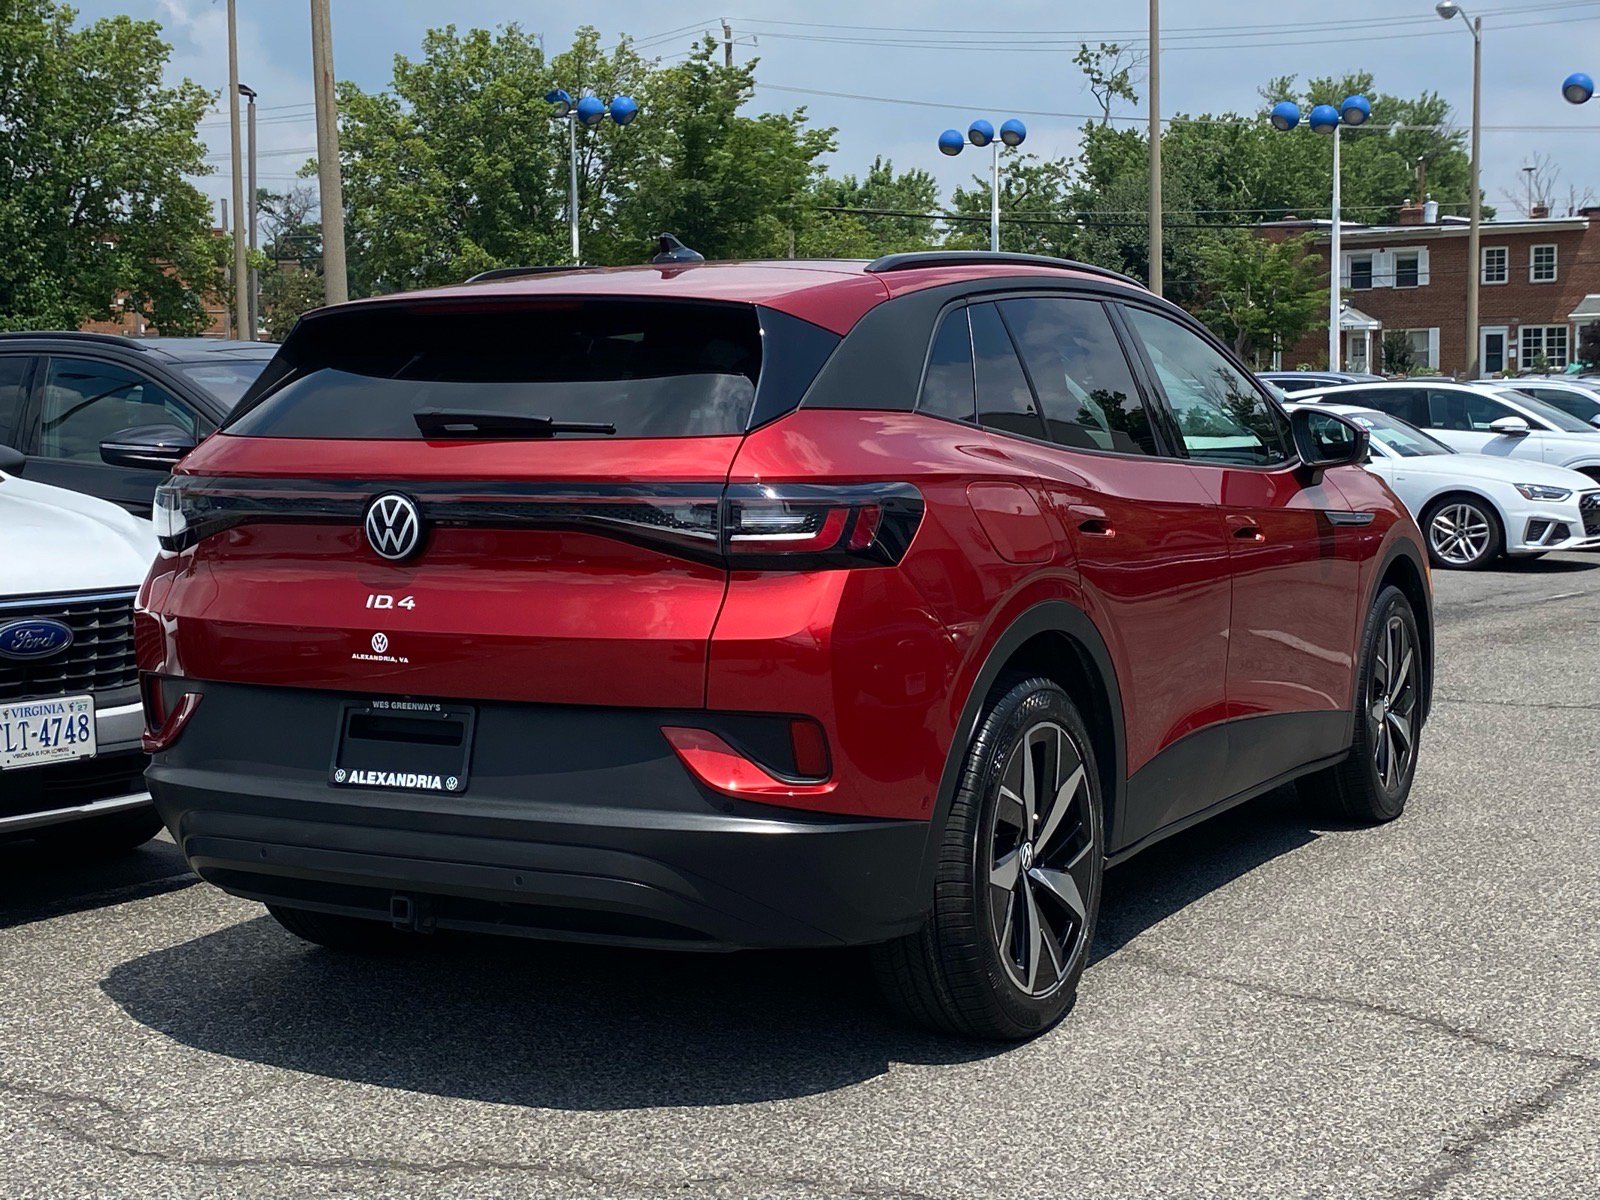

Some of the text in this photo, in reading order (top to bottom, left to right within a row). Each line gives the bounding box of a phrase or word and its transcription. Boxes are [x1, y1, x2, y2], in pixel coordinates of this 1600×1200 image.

[11, 628, 55, 650] Ford
[11, 703, 65, 718] VIRGINIA
[372, 701, 441, 712] WES GREENWAY'S
[349, 770, 442, 789] ALEXANDRIA
